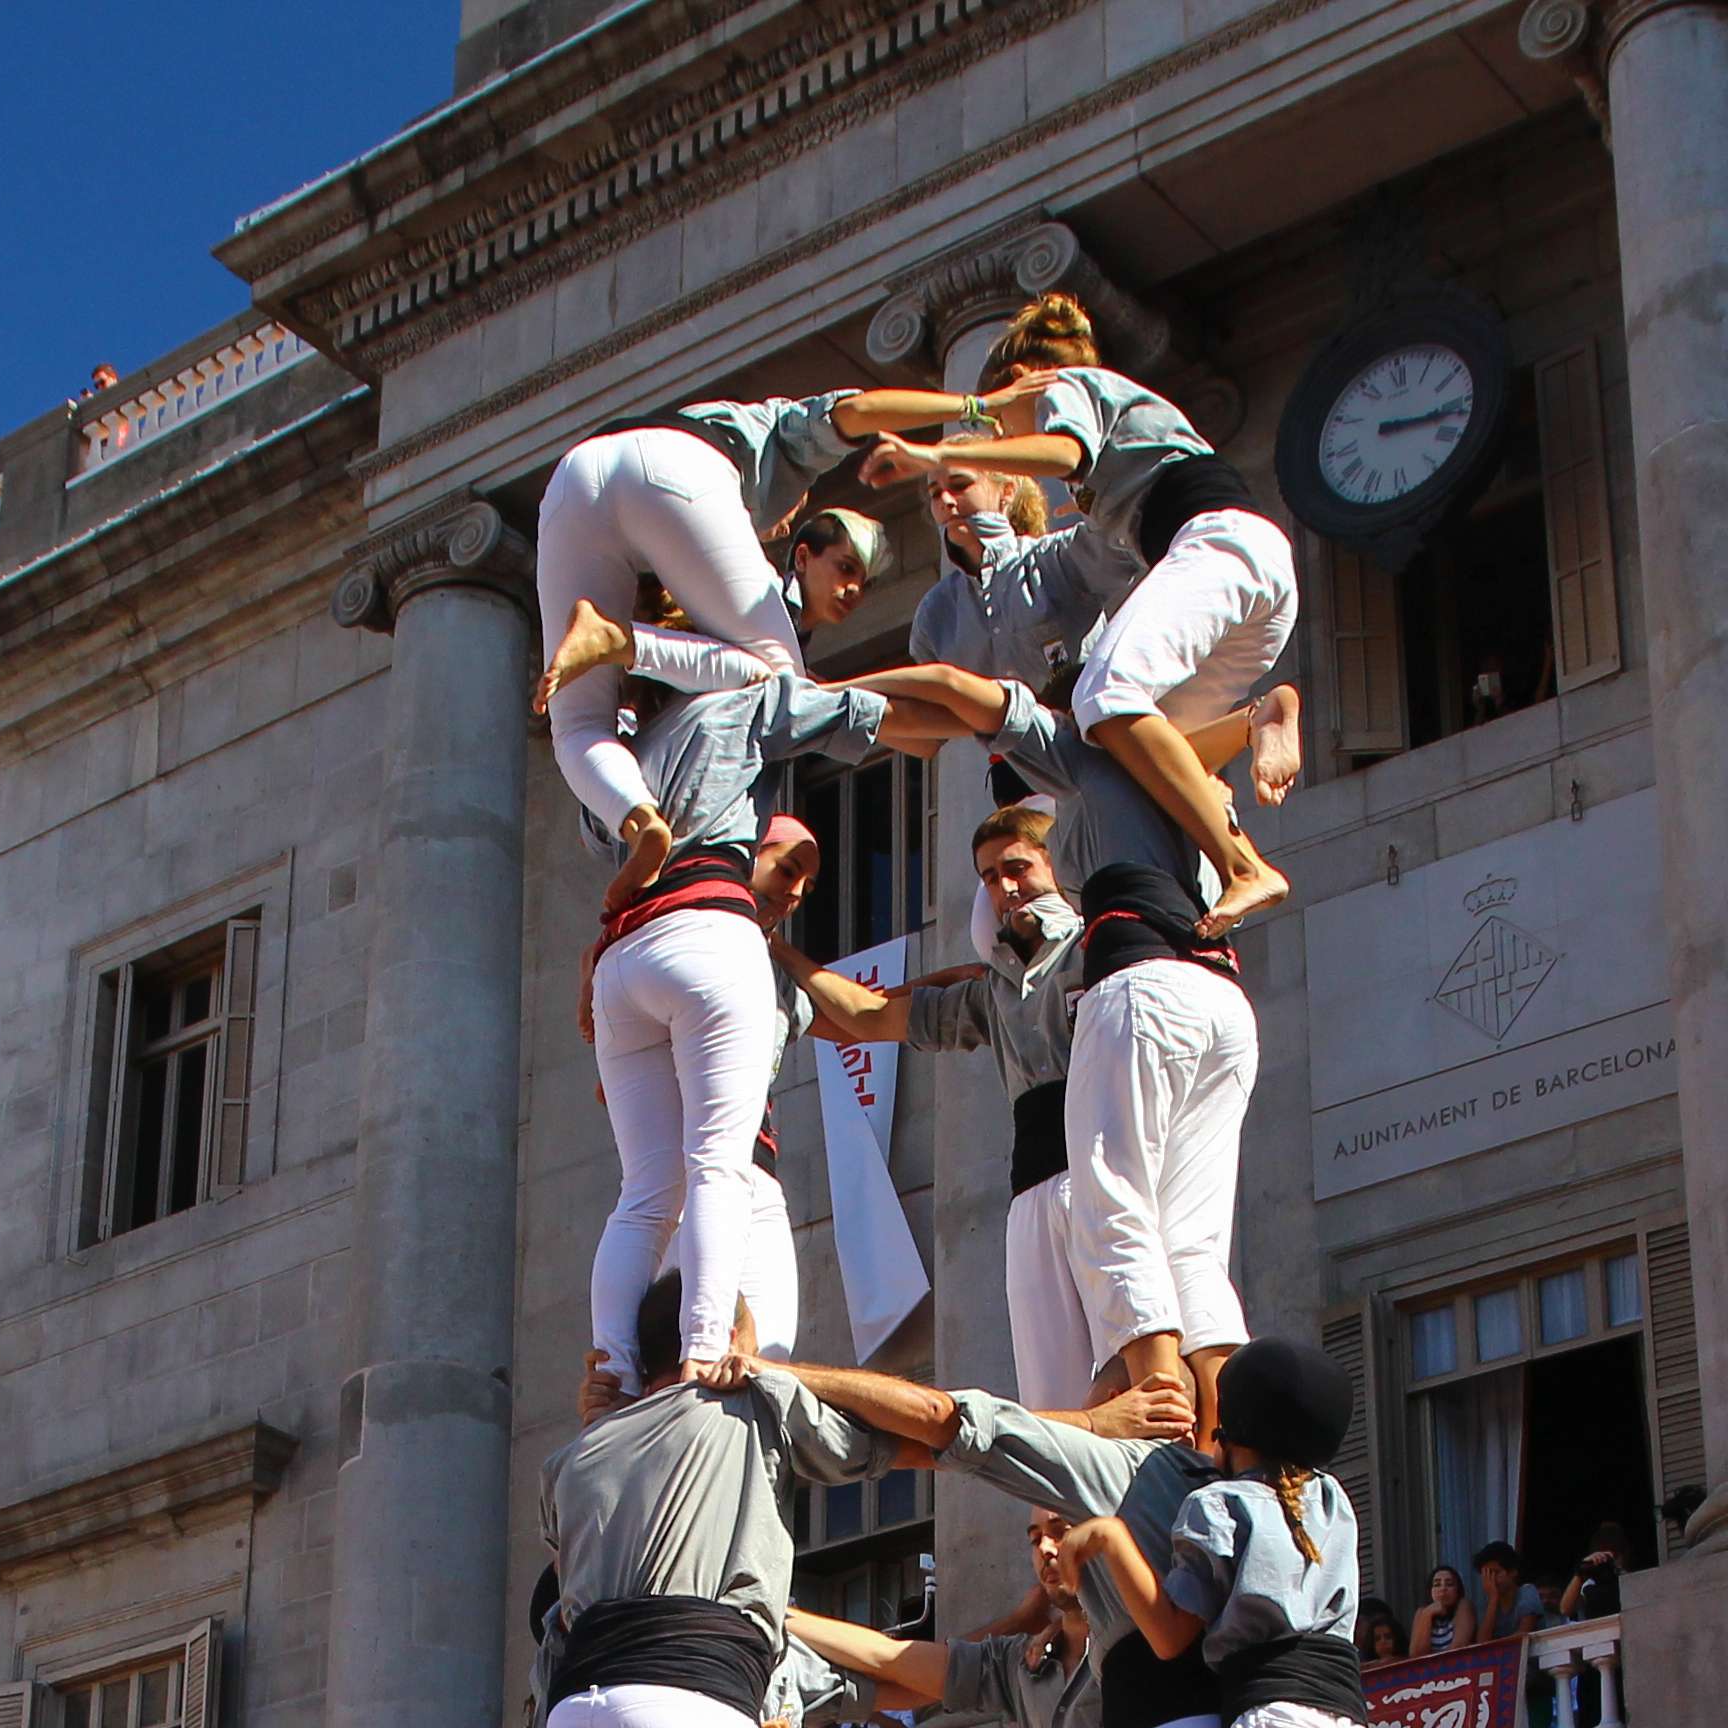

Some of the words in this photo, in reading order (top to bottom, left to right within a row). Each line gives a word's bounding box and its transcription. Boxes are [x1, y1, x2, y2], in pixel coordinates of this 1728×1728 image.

[1332, 1098, 1478, 1160] AJUNTAMENT
[1491, 1085, 1522, 1112] DE
[1535, 1037, 1678, 1098] BARCELONA
